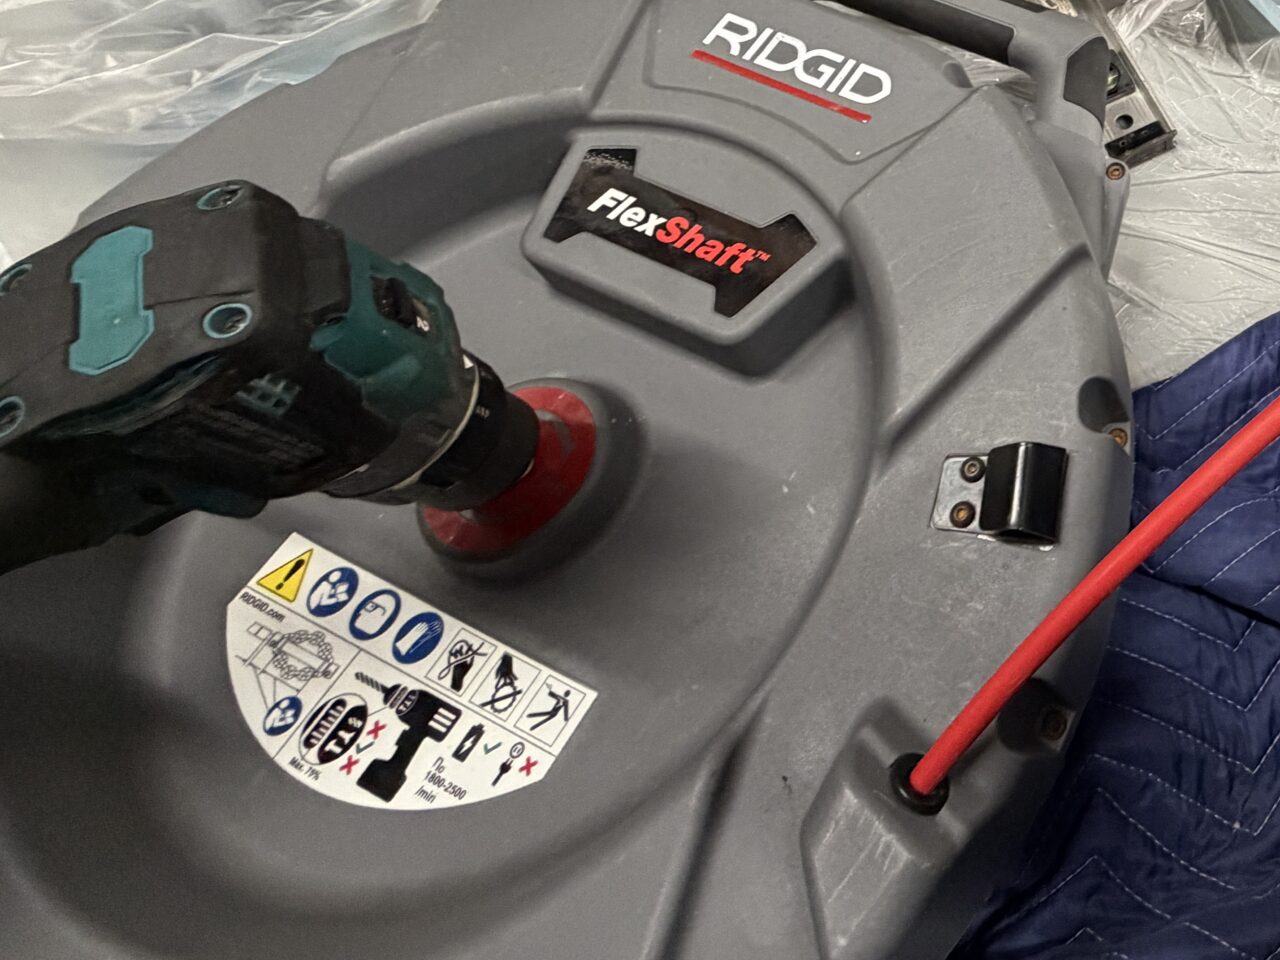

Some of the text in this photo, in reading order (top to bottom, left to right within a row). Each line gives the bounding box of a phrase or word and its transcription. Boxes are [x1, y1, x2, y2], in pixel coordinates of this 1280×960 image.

[703, 13, 892, 105] RIDGID
[239, 592, 286, 622] RIDGID.com
[424, 770, 467, 801] 1800-2500
